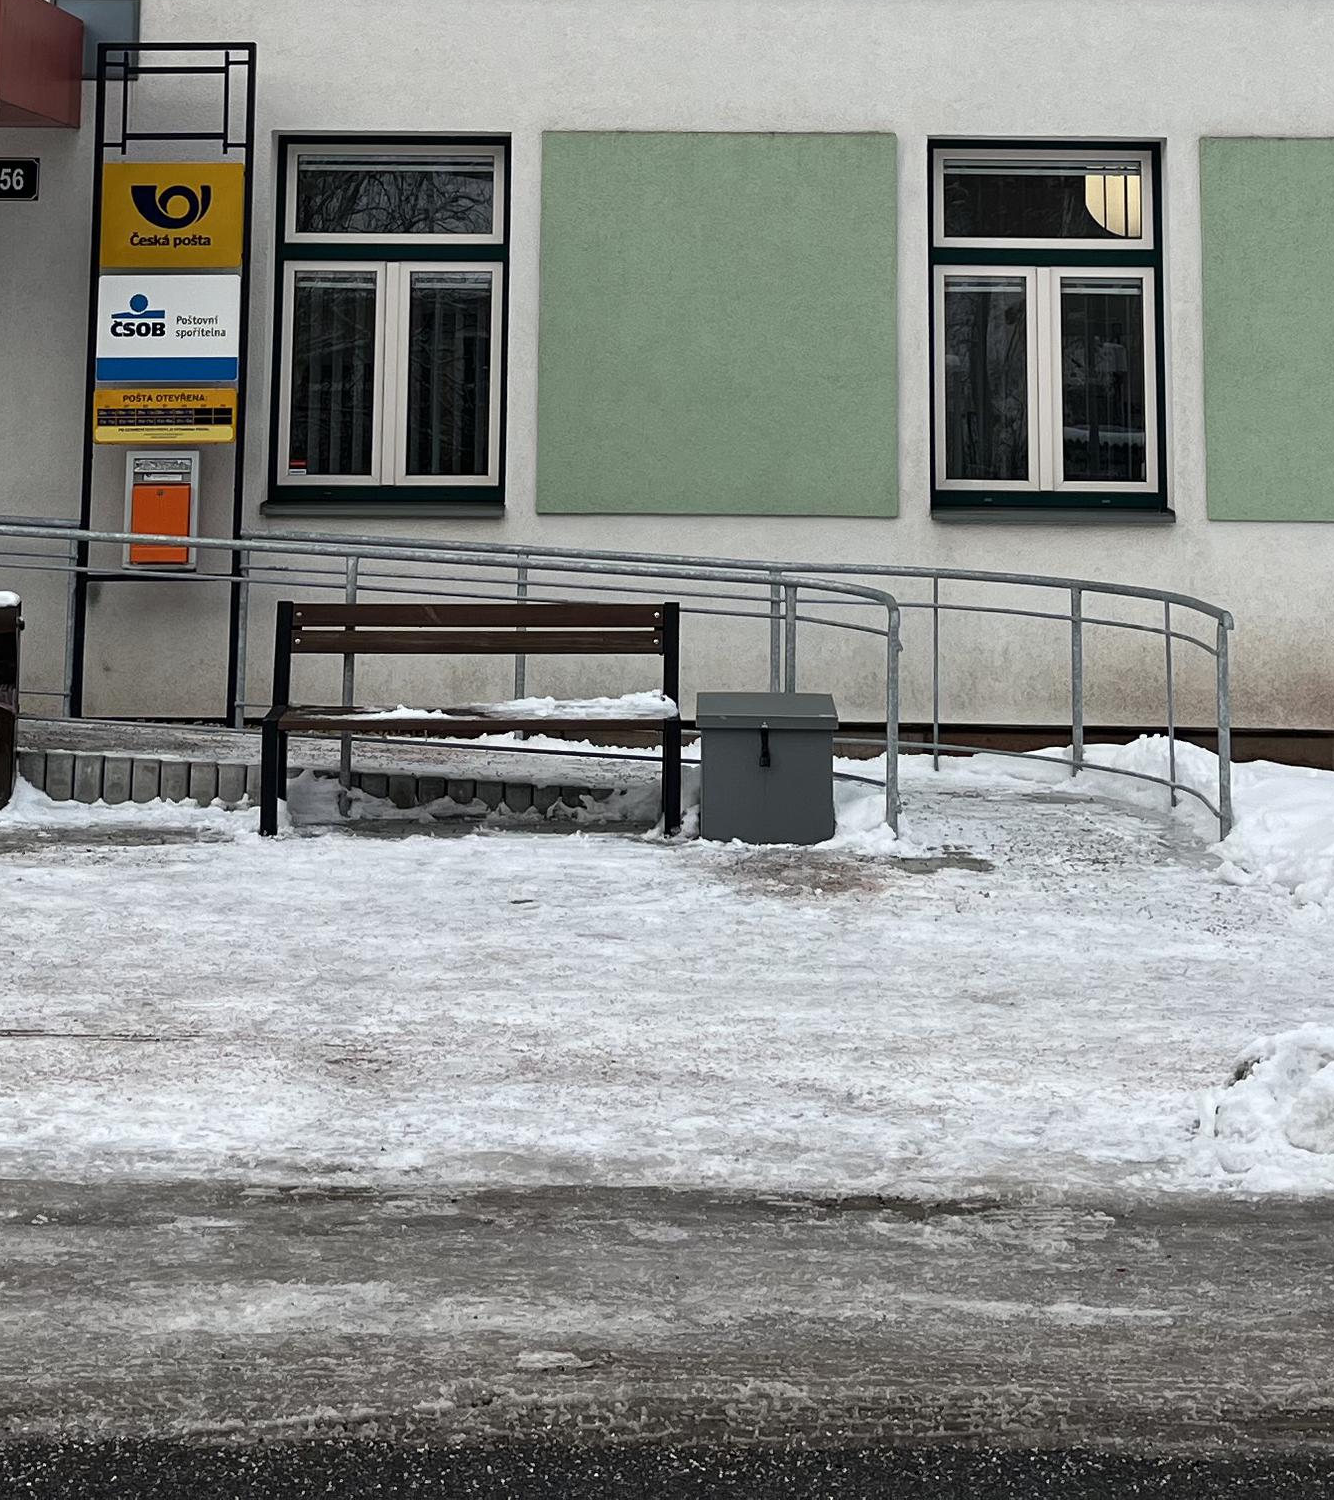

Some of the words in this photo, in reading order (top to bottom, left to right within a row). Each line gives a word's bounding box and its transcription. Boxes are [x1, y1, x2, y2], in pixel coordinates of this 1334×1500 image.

[0, 168, 24, 191] 56
[130, 232, 170, 246] Česká
[173, 234, 211, 248] pošta
[176, 315, 218, 325] Poštovní
[110, 320, 166, 337] ČSOB
[175, 327, 226, 338] spořitelna
[122, 392, 153, 403] POŠTA
